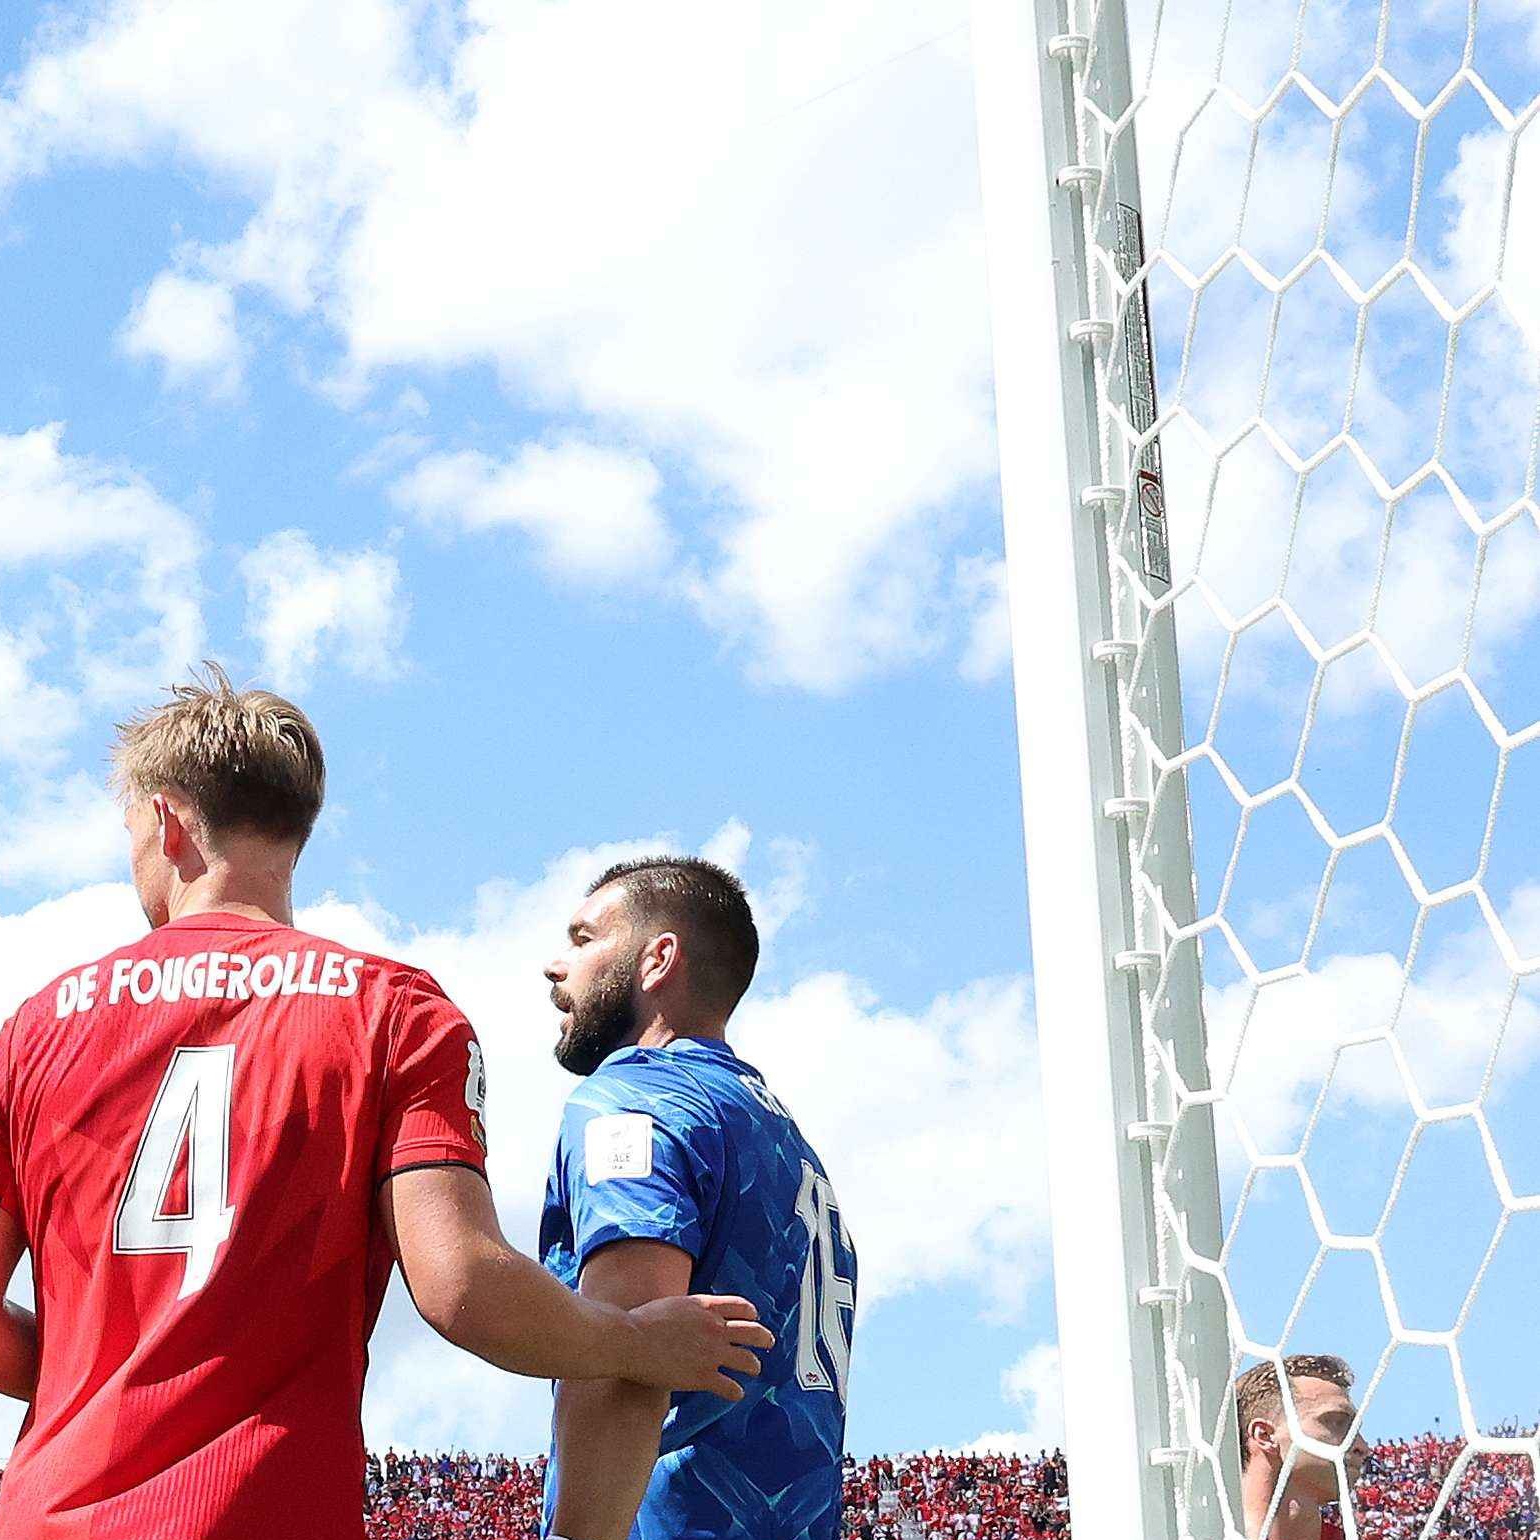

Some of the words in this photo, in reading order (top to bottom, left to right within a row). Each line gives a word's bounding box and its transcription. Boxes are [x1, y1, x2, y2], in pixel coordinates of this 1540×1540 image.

[55, 964, 99, 1020] DE
[108, 950, 365, 1006] FOUGEROLLES
[112, 1043, 237, 1301] 4
